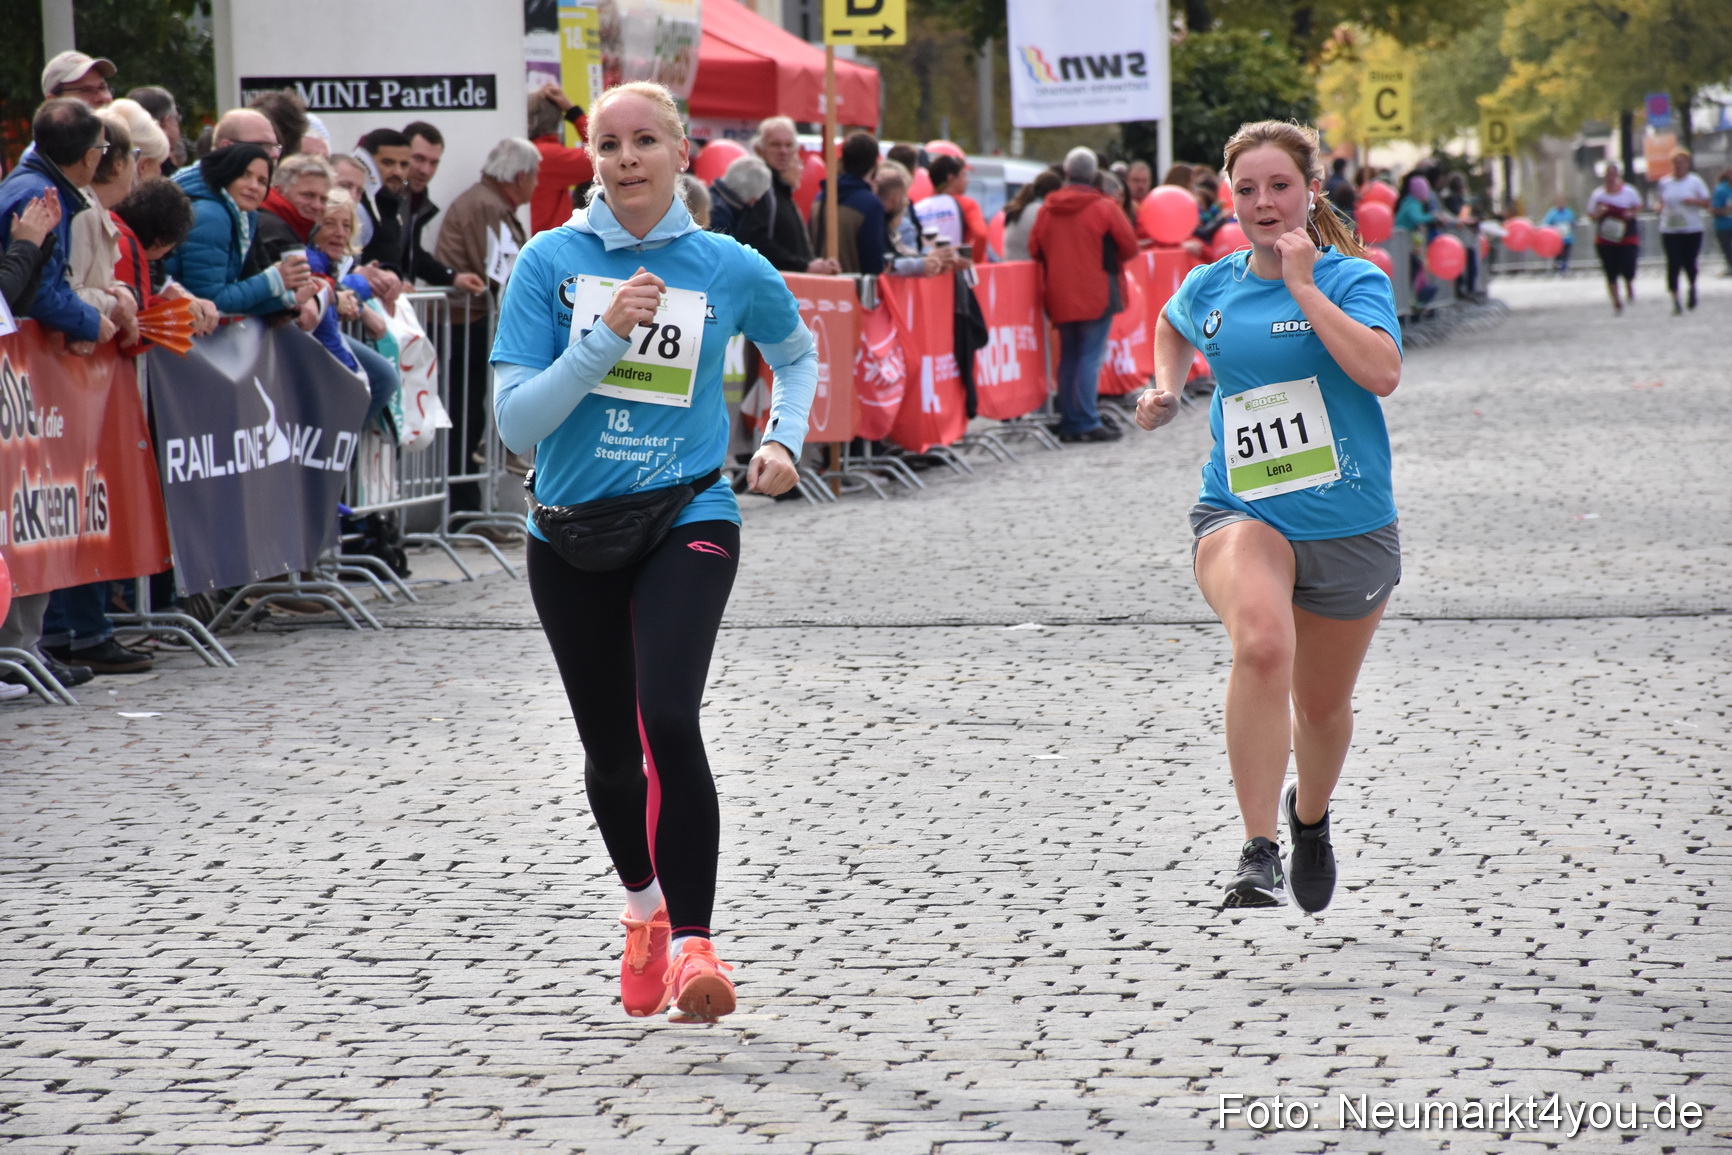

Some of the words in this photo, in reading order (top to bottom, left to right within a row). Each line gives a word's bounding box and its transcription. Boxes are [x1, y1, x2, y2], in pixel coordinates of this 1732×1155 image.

[1375, 87, 1397, 120] C
[1489, 120, 1507, 144] D
[1271, 320, 1313, 334] BOC
[607, 365, 652, 382] Andrea
[1251, 392, 1288, 409] BOCK
[605, 408, 634, 432] 18.
[600, 431, 669, 447] Neumarkter
[1237, 412, 1309, 459] 5111
[166, 424, 266, 484] RAIL.ONE
[594, 446, 654, 464] Stadtlauf
[639, 465, 668, 488] September
[1267, 462, 1293, 477] Lena
